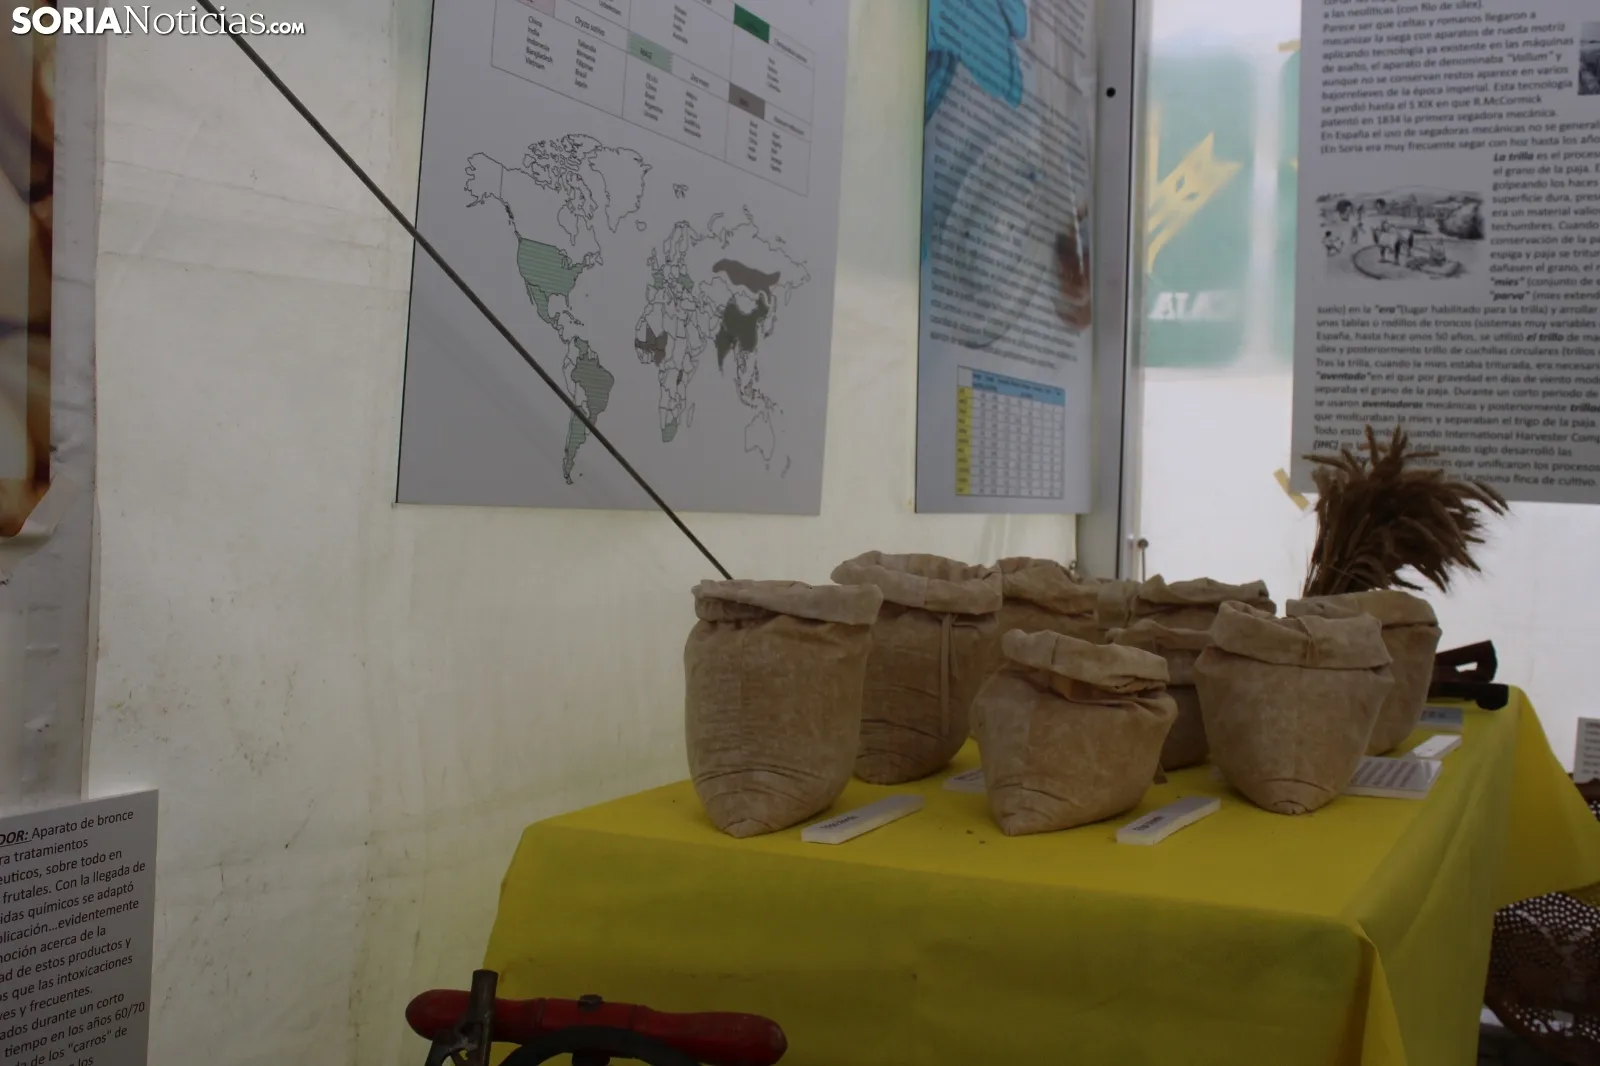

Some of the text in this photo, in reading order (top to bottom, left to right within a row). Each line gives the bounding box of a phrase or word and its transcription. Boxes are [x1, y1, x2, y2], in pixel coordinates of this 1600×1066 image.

[1321, 116, 1358, 129] patentó
[1377, 114, 1400, 124] 1834
[1403, 114, 1412, 123] la
[1414, 114, 1454, 125] primera
[1457, 111, 1503, 123] segadora
[1505, 109, 1558, 119] mecánica.
[1320, 130, 1332, 140] En
[1335, 129, 1369, 141] España
[1372, 128, 1381, 138] el
[1403, 127, 1415, 137] de
[1419, 126, 1469, 138] segadoras
[1472, 124, 1525, 134] mecánicas
[1320, 144, 1335, 156] (En
[1338, 143, 1362, 153] Soria
[1384, 144, 1404, 153] muy
[1407, 141, 1455, 150] frecuente
[1458, 141, 1485, 150] segar
[1509, 138, 1528, 147] hoz
[1530, 137, 1559, 146] hasta
[1562, 136, 1577, 145] los
[1493, 152, 1506, 161] La
[1508, 151, 1534, 161] trilla
[1550, 150, 1560, 160] el
[1493, 164, 1591, 177] el grano de la paja.
[1492, 178, 1598, 190] golpeando los haces
[1492, 193, 1572, 205] superficie dura,
[1526, 206, 1570, 216] material
[1491, 220, 1599, 231] techumbres. Cuando
[1490, 235, 1586, 245] conservación de la
[1490, 250, 1522, 261] espiga
[1525, 252, 1530, 261] y
[1533, 249, 1556, 261] paja
[1489, 262, 1593, 274] dañasen el grano, el
[1490, 276, 1593, 288] "mies" (conjunto de
[1490, 290, 1560, 302] "parva" (mies
[1315, 426, 1567, 441] Todo esto International Harvester
[1414, 442, 1431, 451] del
[1474, 444, 1497, 456] siglo
[1500, 445, 1554, 456] desarrolló
[1557, 446, 1572, 456] las
[1454, 459, 1600, 472] que unificaron los procesos
[1513, 473, 1539, 484] finca
[1541, 475, 1555, 484] de
[1557, 476, 1598, 486] cultivo.
[31, 820, 77, 841] Aparato
[80, 815, 94, 830] de
[97, 811, 133, 827] bronce
[14, 840, 87, 864] tratamientos
[46, 858, 77, 876] sobre
[81, 851, 106, 869] todo
[109, 850, 121, 863] en
[2, 860, 145, 904] frutales. Con la llegada de
[27, 897, 79, 921] químicos
[82, 894, 94, 906] se
[97, 881, 133, 903] adaptó
[40, 936, 76, 954] acerca
[80, 929, 93, 944] de
[96, 925, 105, 941] la
[16, 964, 31, 979] de
[35, 957, 65, 974] estos
[68, 941, 122, 968] productos
[125, 939, 130, 953] y
[11, 983, 34, 1002] que
[38, 977, 53, 992] las
[57, 955, 132, 987] intoxicaciones
[19, 1005, 26, 1019] y
[29, 988, 92, 1014] frecuentes.
[31, 1009, 76, 1032] durante
[79, 1004, 93, 1017] un
[96, 994, 124, 1012] corto
[4, 1000, 144, 1058] tiempo en los años 60/70
[29, 1052, 45, 1066] de
[48, 1046, 64, 1062] los
[68, 1028, 111, 1054] "carros"
[114, 1025, 127, 1040] de
